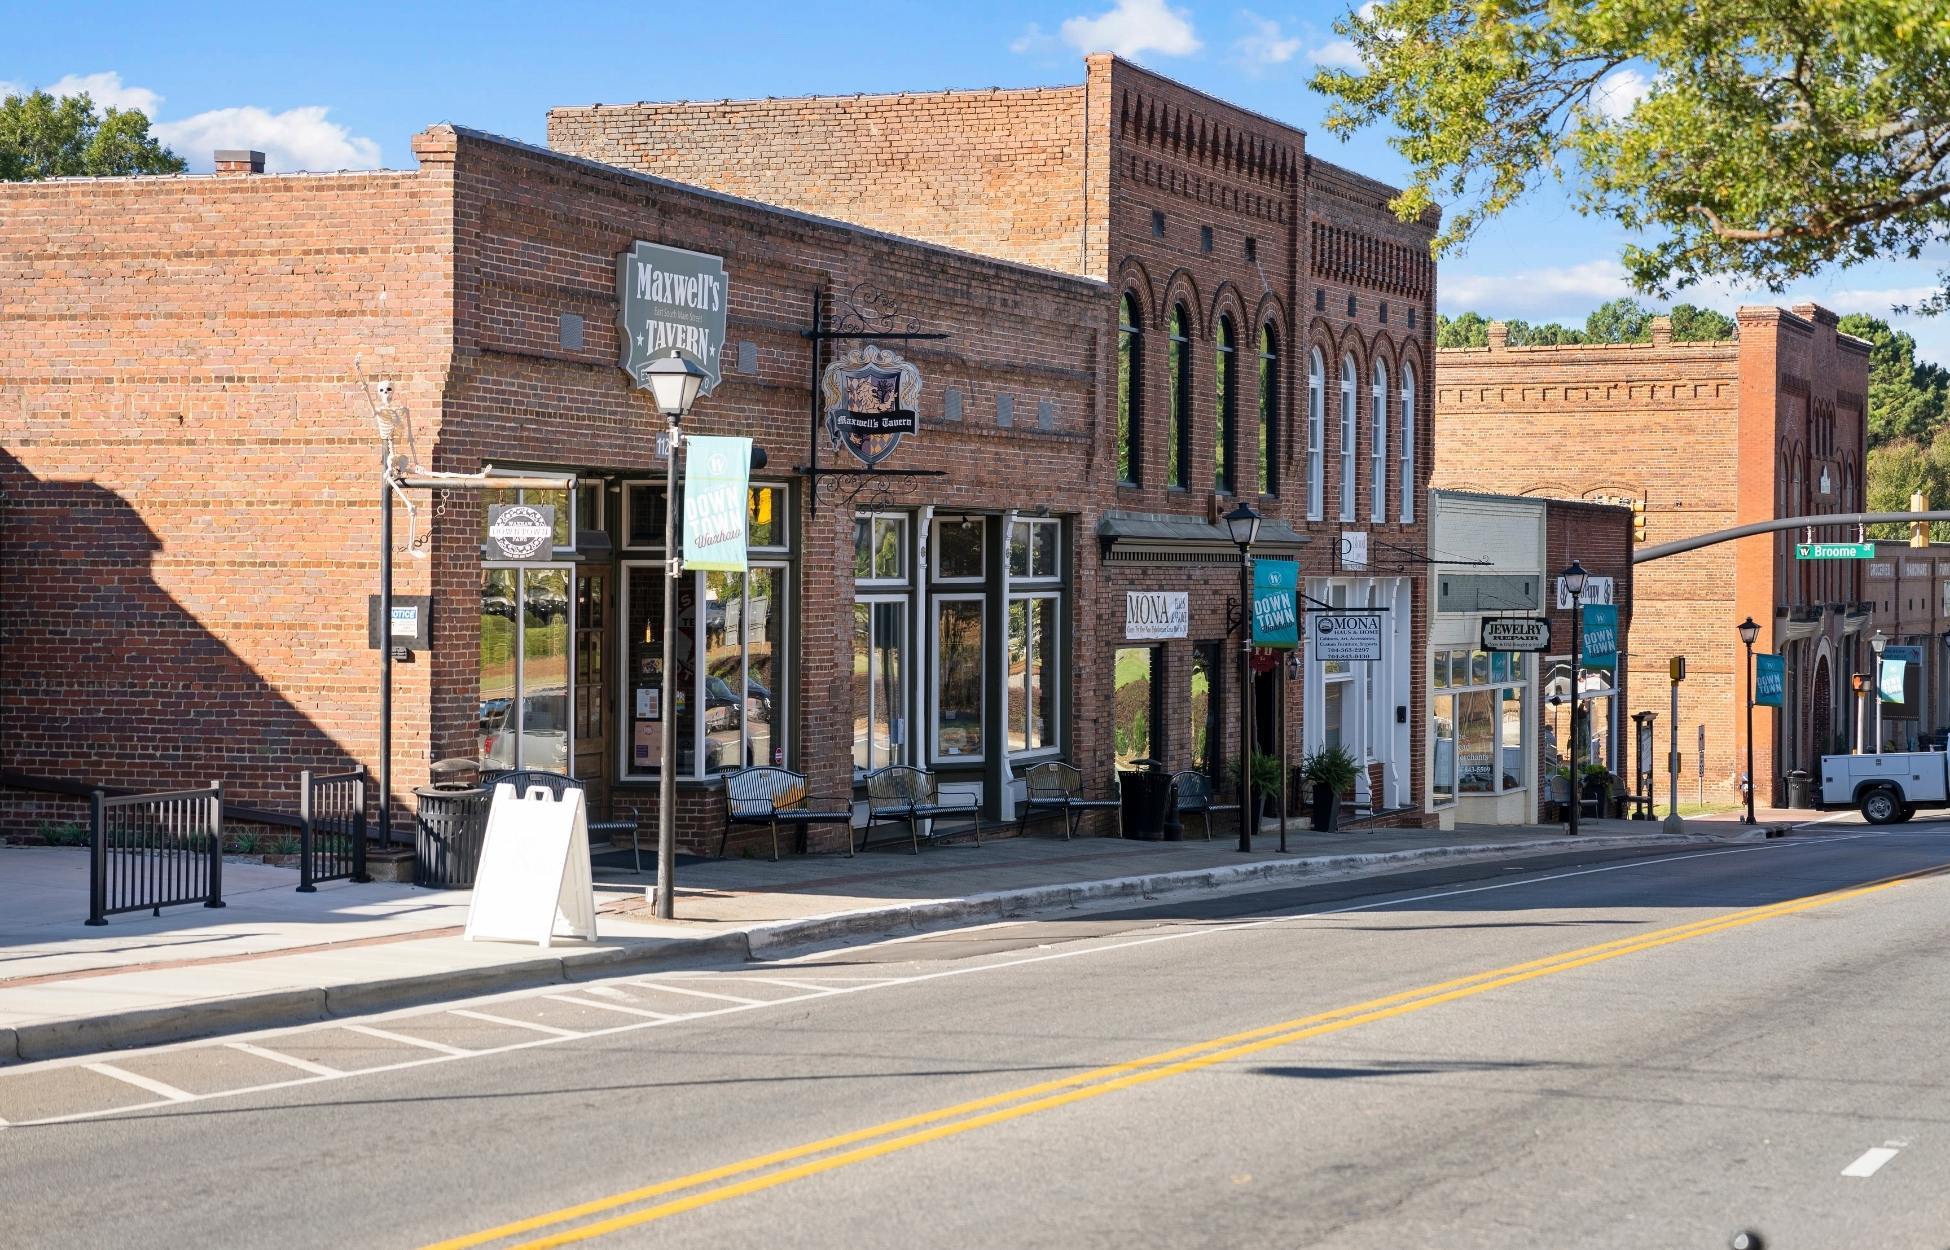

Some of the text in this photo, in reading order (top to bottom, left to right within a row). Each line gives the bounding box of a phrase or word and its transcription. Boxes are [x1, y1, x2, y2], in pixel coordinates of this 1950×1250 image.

[637, 262, 720, 312] Maxwell's
[646, 320, 710, 366] TAVERN
[838, 415, 912, 428] Maxwell's Tavern
[686, 486, 740, 520] DOWN
[694, 528, 742, 548] Waxhaw
[1814, 547, 1857, 557] Broome
[1128, 595, 1169, 624] MONA
[1254, 592, 1291, 616] DOWN
[1257, 608, 1295, 628] TOWN
[1334, 617, 1378, 630] MONA
[1488, 624, 1544, 635] JEWELRY
[1584, 628, 1614, 645] DOWN
[1585, 640, 1616, 655] TOWN
[1757, 673, 1780, 687] DOWN
[1758, 684, 1783, 695] TOWN
